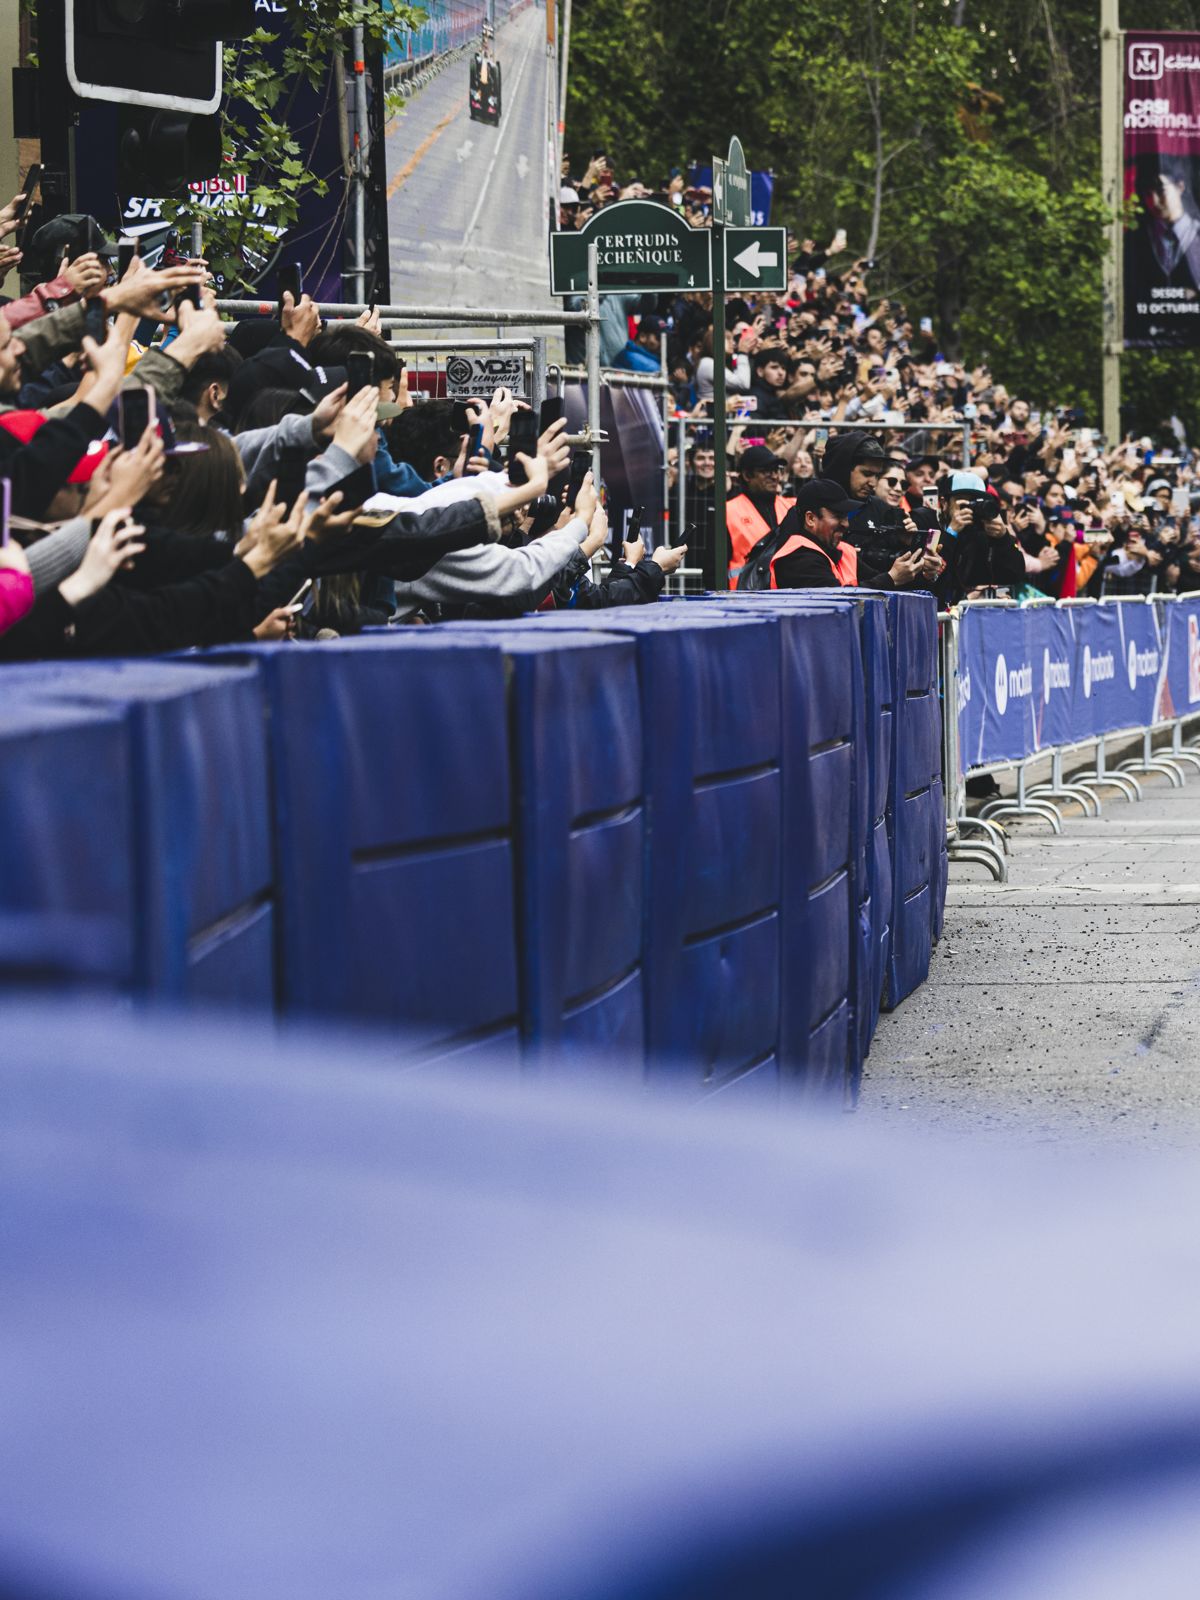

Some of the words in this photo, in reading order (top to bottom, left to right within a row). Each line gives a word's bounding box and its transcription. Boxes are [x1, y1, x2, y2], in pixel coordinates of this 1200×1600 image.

[1129, 98, 1170, 115] CASI
[687, 274, 695, 287] 4
[1149, 302, 1200, 315] OCTUBRE
[474, 359, 521, 375] VDS
